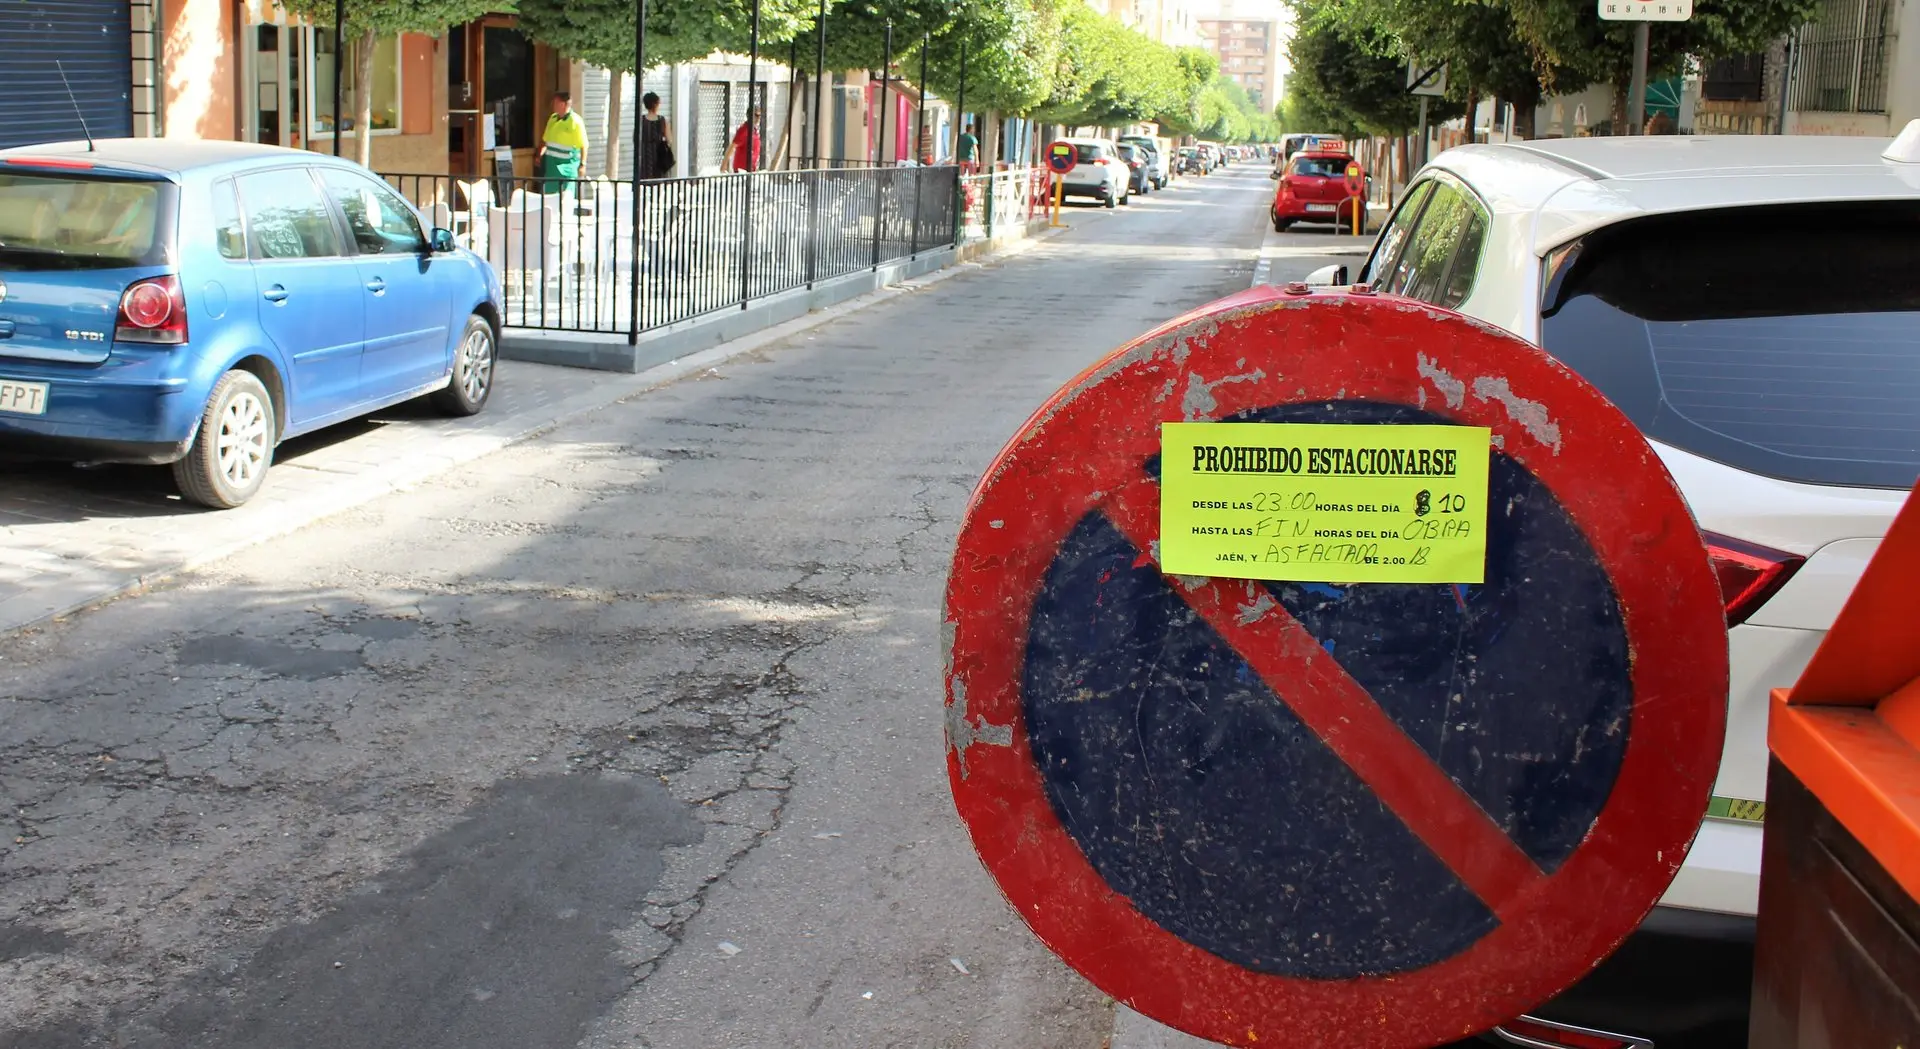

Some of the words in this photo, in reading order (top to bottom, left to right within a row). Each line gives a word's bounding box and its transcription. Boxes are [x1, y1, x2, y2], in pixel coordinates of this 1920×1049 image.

[1607, 4, 1616, 13] DE
[1640, 5, 1647, 14] A
[1676, 5, 1683, 14] H
[1192, 445, 1303, 474] PROHIBIDO
[1307, 447, 1457, 476] ESTACIONARSE
[1192, 500, 1228, 509] DESDE
[1232, 501, 1253, 510] LAS
[1253, 491, 1317, 512] 23:00
[1315, 504, 1353, 513] HORAS
[1357, 504, 1378, 513] DEL
[1381, 503, 1401, 513] DÍA
[1438, 493, 1466, 514] 10
[1192, 526, 1229, 535] HASTA
[1232, 527, 1253, 536] LAS
[1255, 516, 1310, 538] FIN
[1314, 530, 1353, 539] HORAS
[1356, 530, 1377, 539] DEL
[1380, 529, 1400, 539] DÍA
[1403, 518, 1471, 541] OBRA
[1251, 554, 1258, 562] Y
[1364, 556, 1379, 564] DE
[1382, 557, 1405, 565] 2.00
